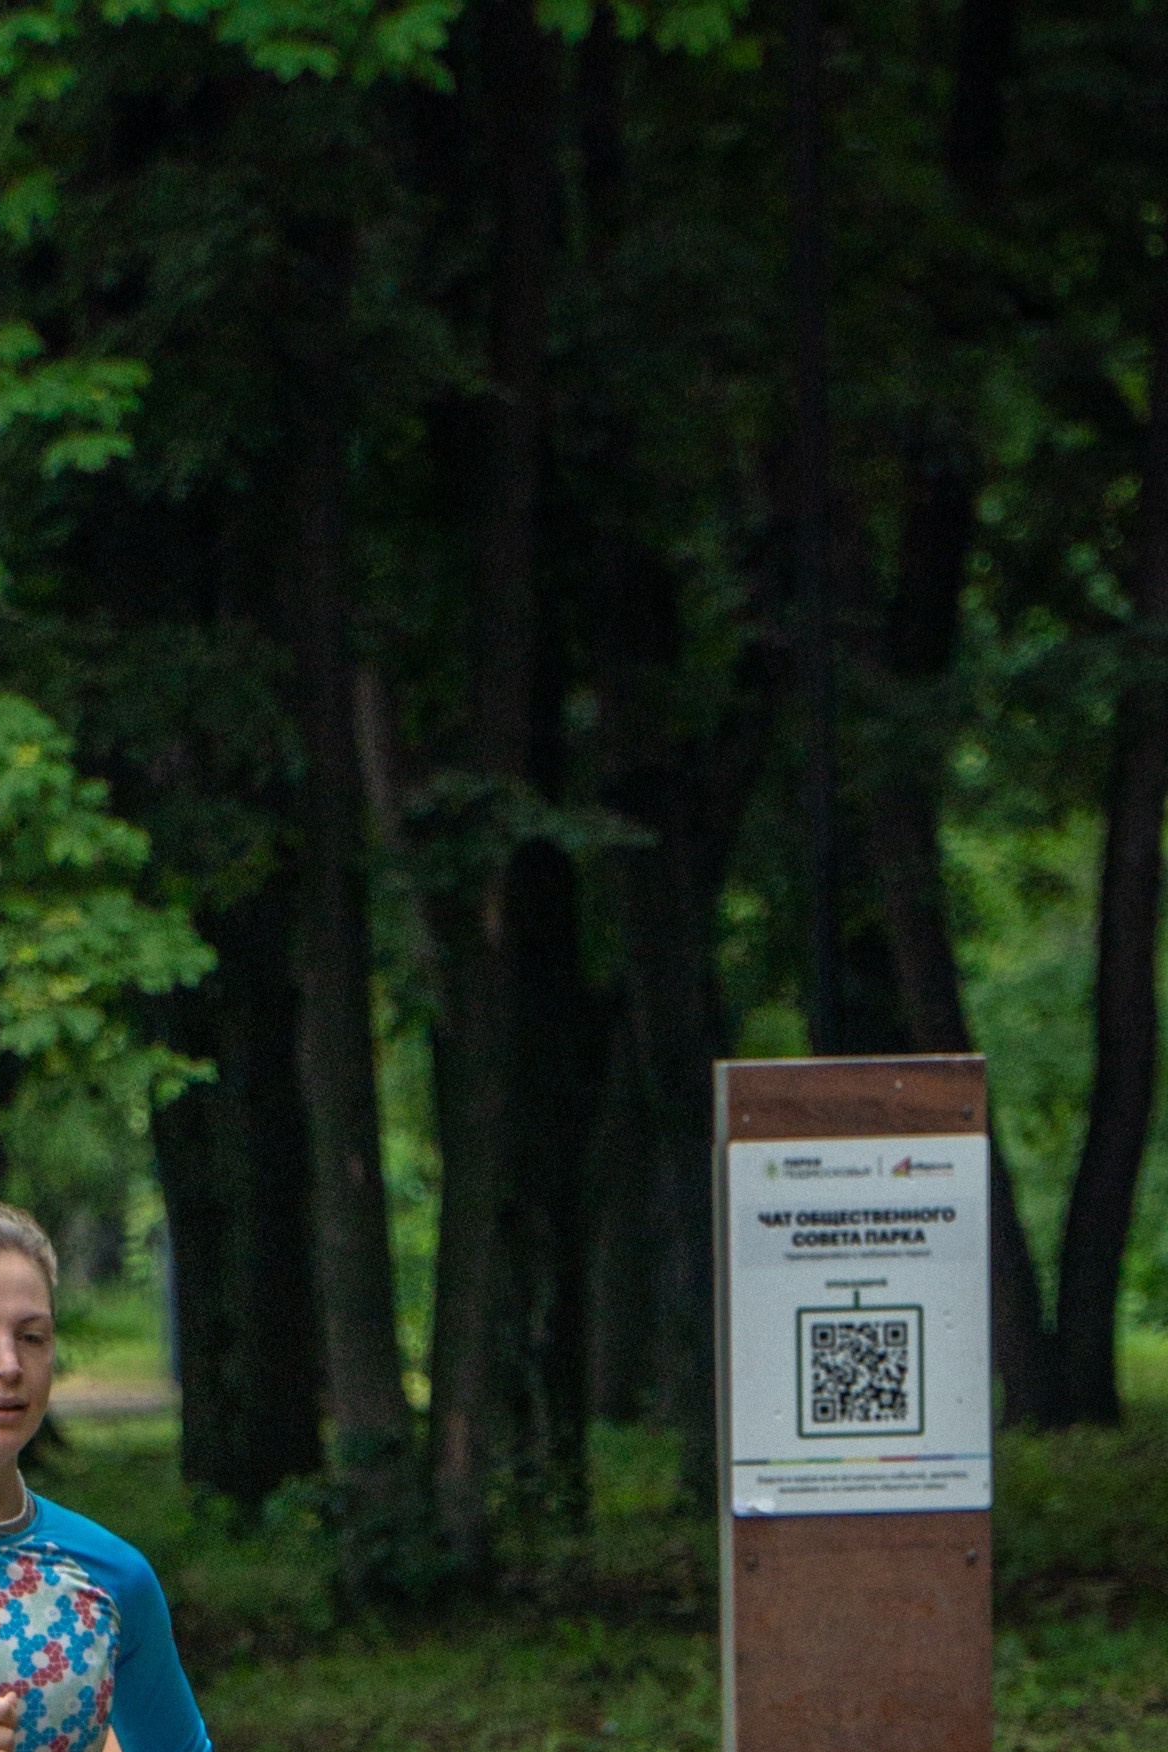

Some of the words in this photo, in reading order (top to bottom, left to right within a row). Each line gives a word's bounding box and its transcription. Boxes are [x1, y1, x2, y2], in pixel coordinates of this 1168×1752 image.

[758, 1211, 792, 1227] ЧАТ
[796, 1206, 956, 1227] ОБЩЕСТВЕННОГО
[792, 1230, 861, 1247] СОВЕТА
[865, 1228, 926, 1245] ПАРКА
